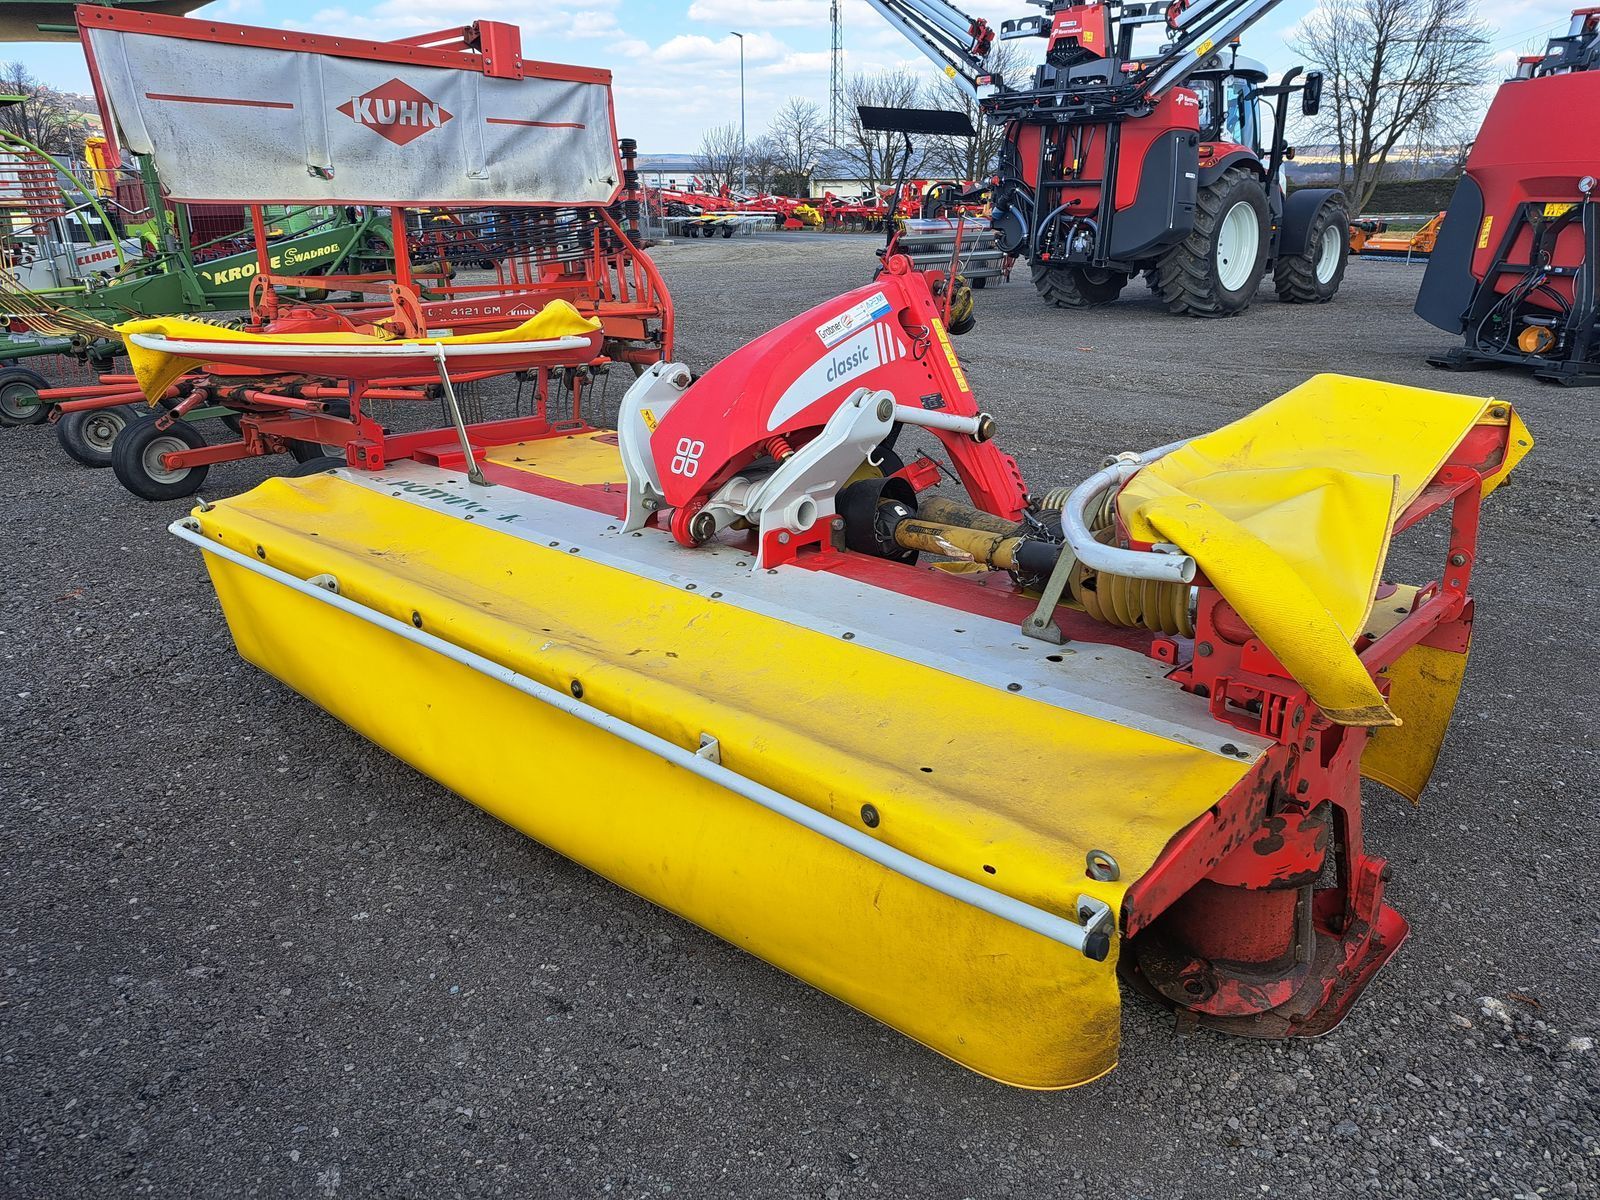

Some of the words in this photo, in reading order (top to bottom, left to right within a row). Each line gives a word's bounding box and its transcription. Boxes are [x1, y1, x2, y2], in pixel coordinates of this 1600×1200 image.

[351, 97, 441, 128] KUHN
[77, 249, 118, 265] CLAAS
[451, 307, 479, 316] 4121
[483, 306, 501, 314] GM
[826, 345, 870, 382] classic
